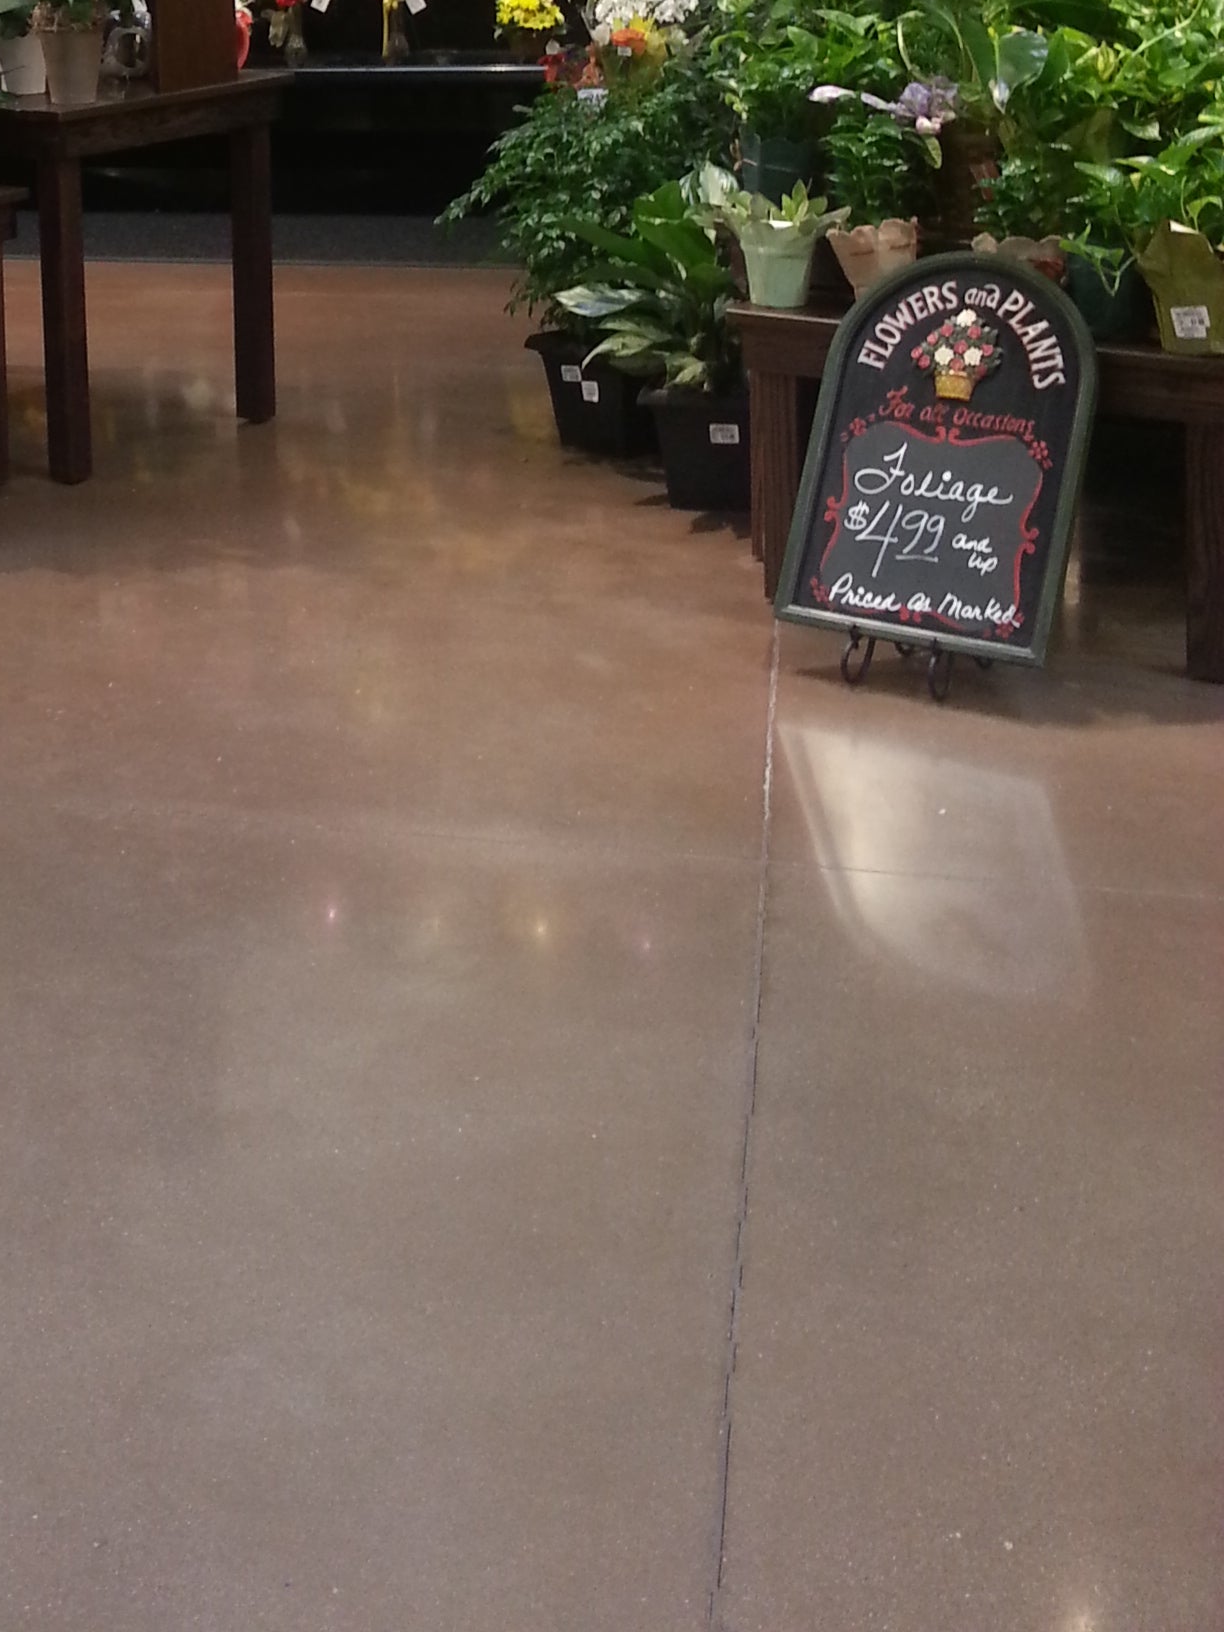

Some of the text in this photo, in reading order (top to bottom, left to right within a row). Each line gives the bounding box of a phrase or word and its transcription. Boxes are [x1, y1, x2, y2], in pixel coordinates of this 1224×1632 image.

[856, 280, 1067, 391] FLOWERS and PLANTS
[878, 384, 916, 419] For
[953, 407, 1036, 443] Occasions
[853, 441, 1014, 523] Foliage
[951, 534, 994, 555] and
[967, 552, 999, 577] up
[828, 572, 902, 612] Priced
[937, 591, 1022, 629] Marked
